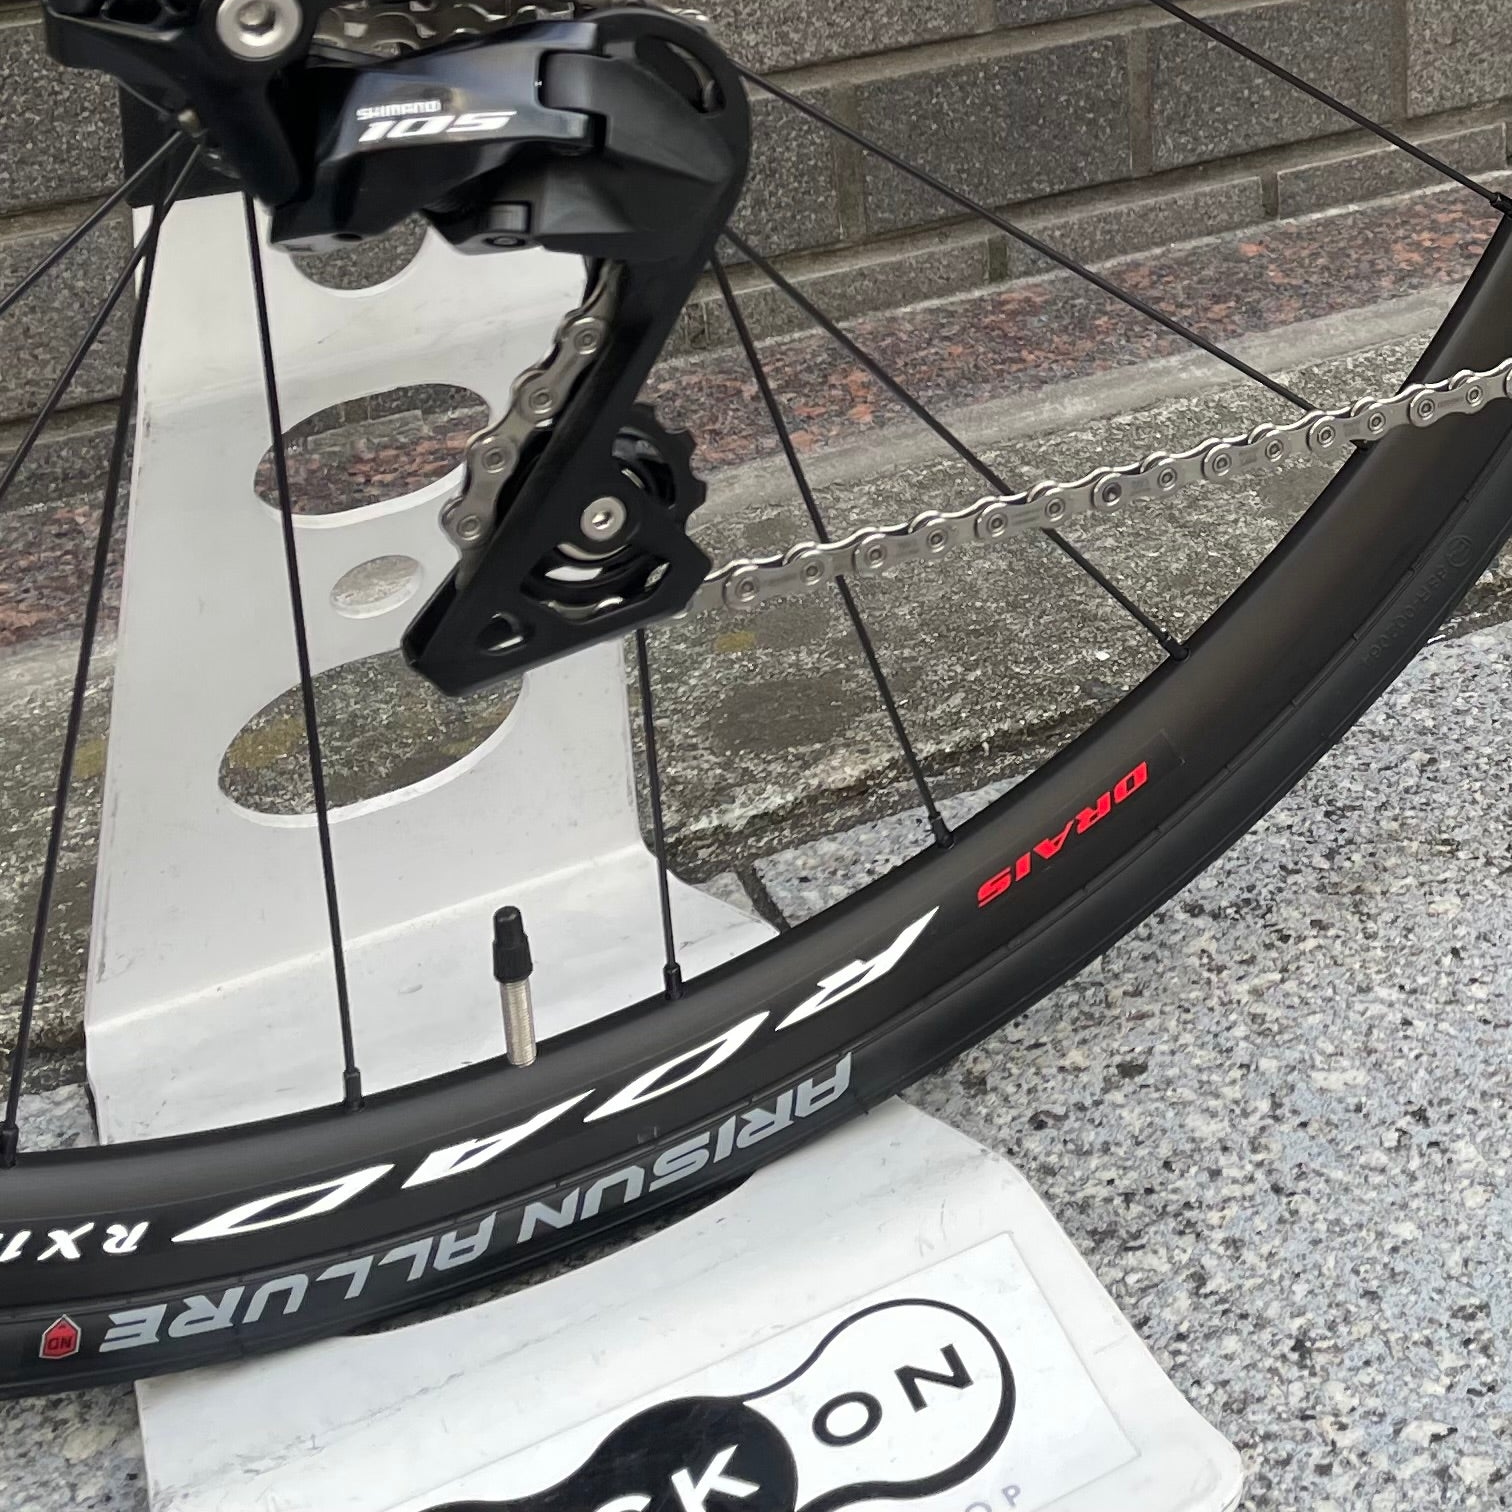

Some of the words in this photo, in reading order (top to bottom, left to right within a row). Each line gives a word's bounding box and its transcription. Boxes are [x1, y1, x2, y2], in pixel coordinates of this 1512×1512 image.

[356, 99, 442, 121] SHIMANO
[358, 110, 518, 143] 105
[977, 761, 1148, 908] DRAIS
[172, 905, 940, 1242] ROAD
[517, 1051, 853, 1244] ARISUN
[0, 1220, 148, 1262] RX1
[99, 1212, 500, 1354] ALLURE
[811, 1343, 974, 1447] ON
